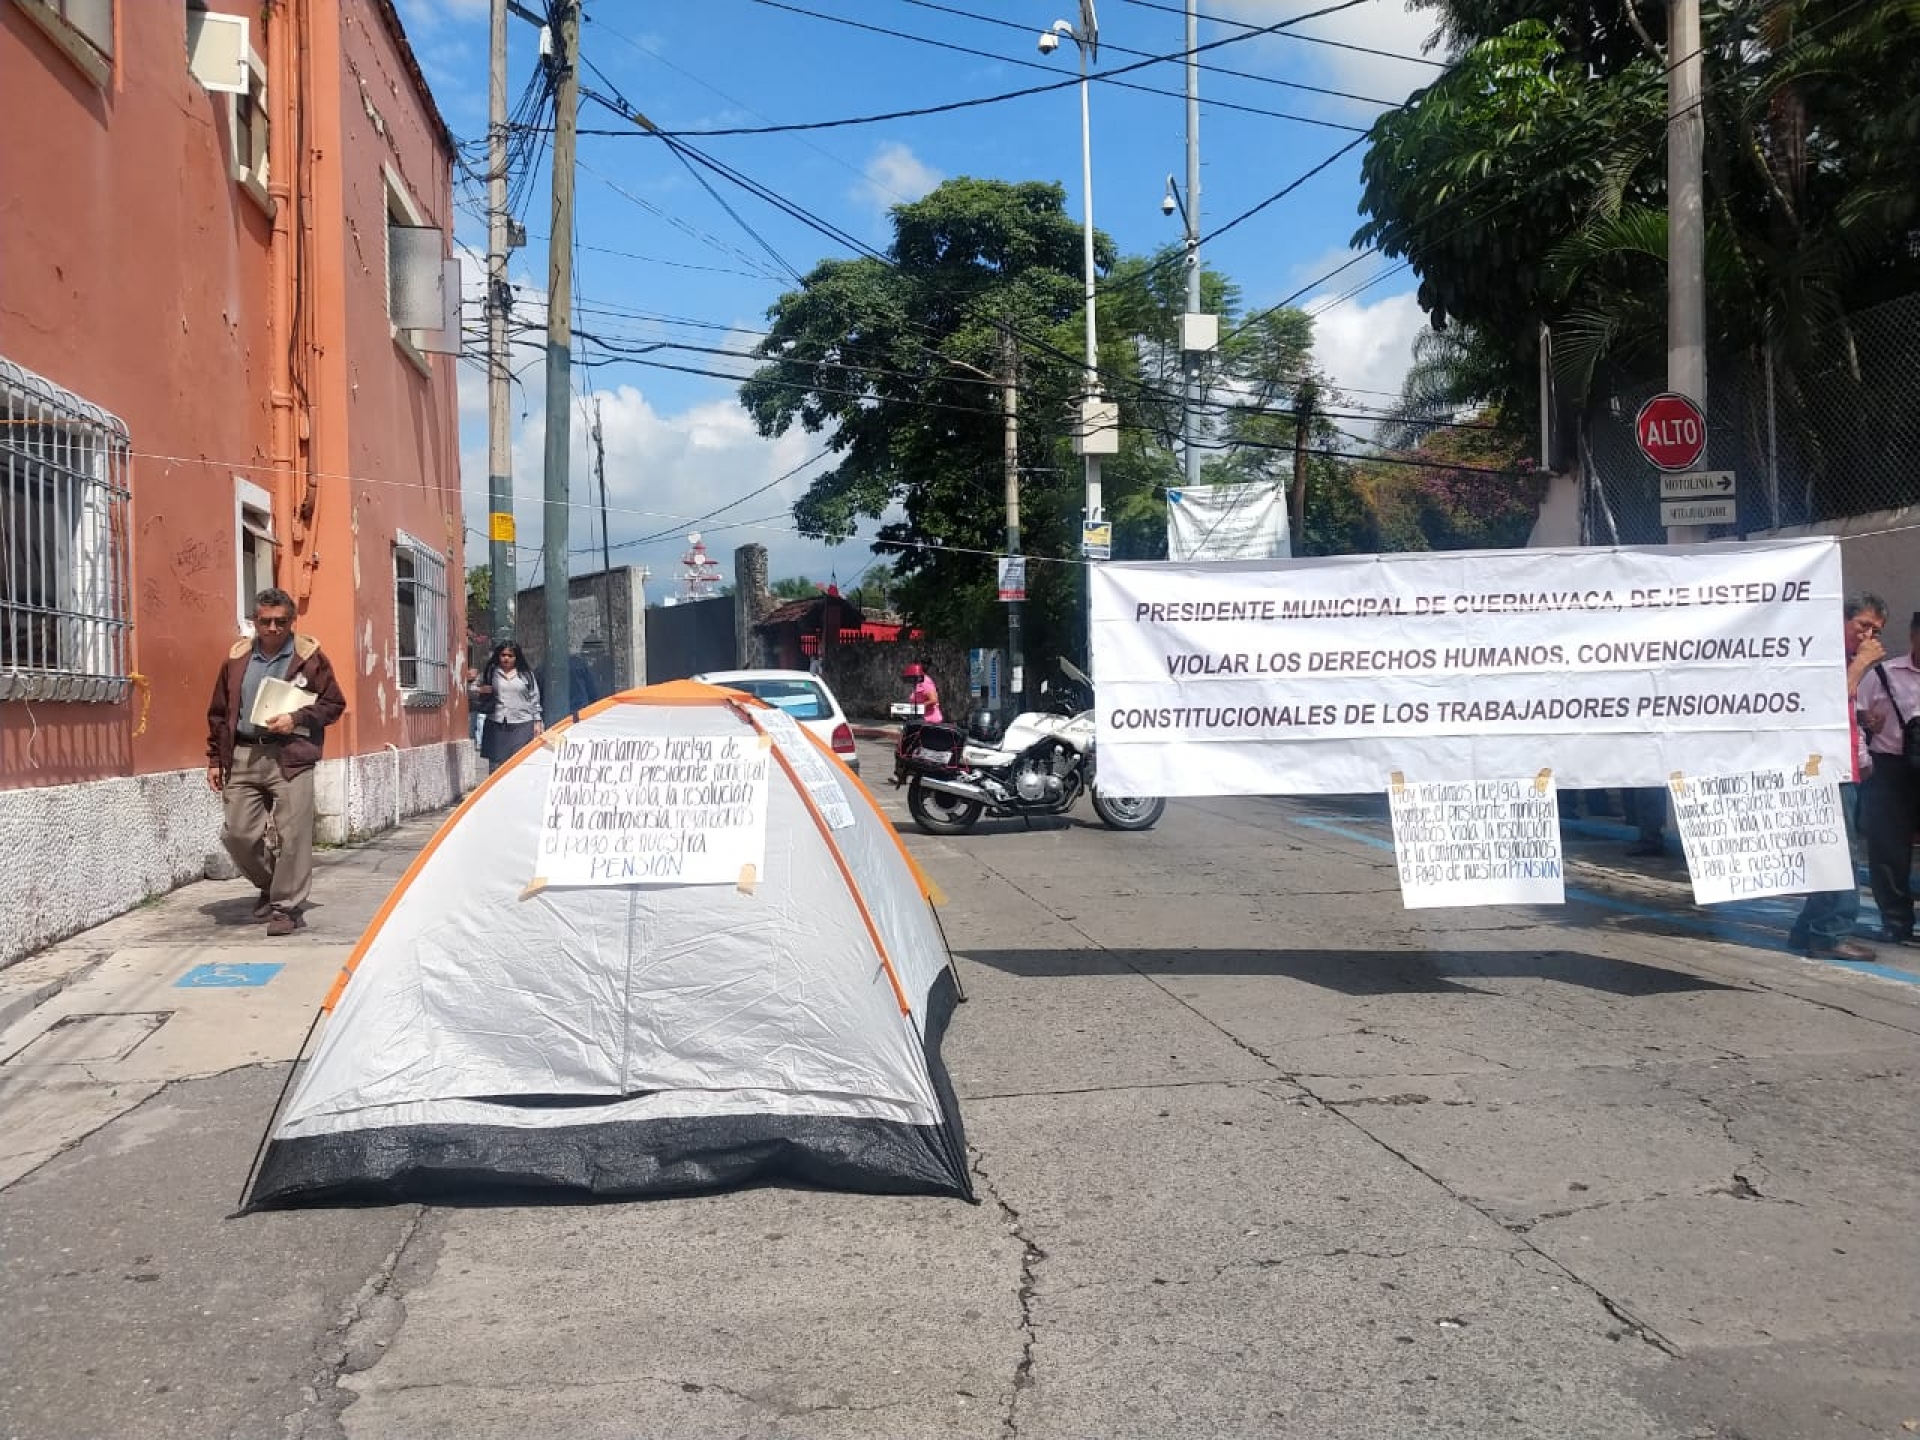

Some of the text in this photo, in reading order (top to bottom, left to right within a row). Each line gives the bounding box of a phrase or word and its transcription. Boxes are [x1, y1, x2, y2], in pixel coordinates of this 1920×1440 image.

[1647, 419, 1697, 446] ALTO
[1136, 581, 1811, 623] PRESIDENTE MUNICIPAL DE CUERNAVACA, DEJE USTED DE
[1167, 654, 1249, 675] VIOLAR
[1256, 653, 1300, 673] LOS
[1308, 649, 1437, 672] DERECHOS
[1577, 637, 1790, 663] CONVENCIONALES
[1799, 636, 1813, 656] Y
[1111, 692, 1806, 729] CONSTITUCIONALES DE LOS TRABAJADORES PENSIONADOS.
[557, 737, 585, 765] Hoy
[665, 736, 711, 763] huelga
[721, 736, 741, 760] de
[620, 762, 633, 783] el
[640, 760, 708, 786] presidente
[666, 784, 678, 806] la
[547, 804, 563, 829] de
[571, 805, 584, 829] la
[546, 828, 706, 859] el pago de nuestra
[1446, 861, 1461, 881] de
[1749, 849, 1805, 874] nuestra
